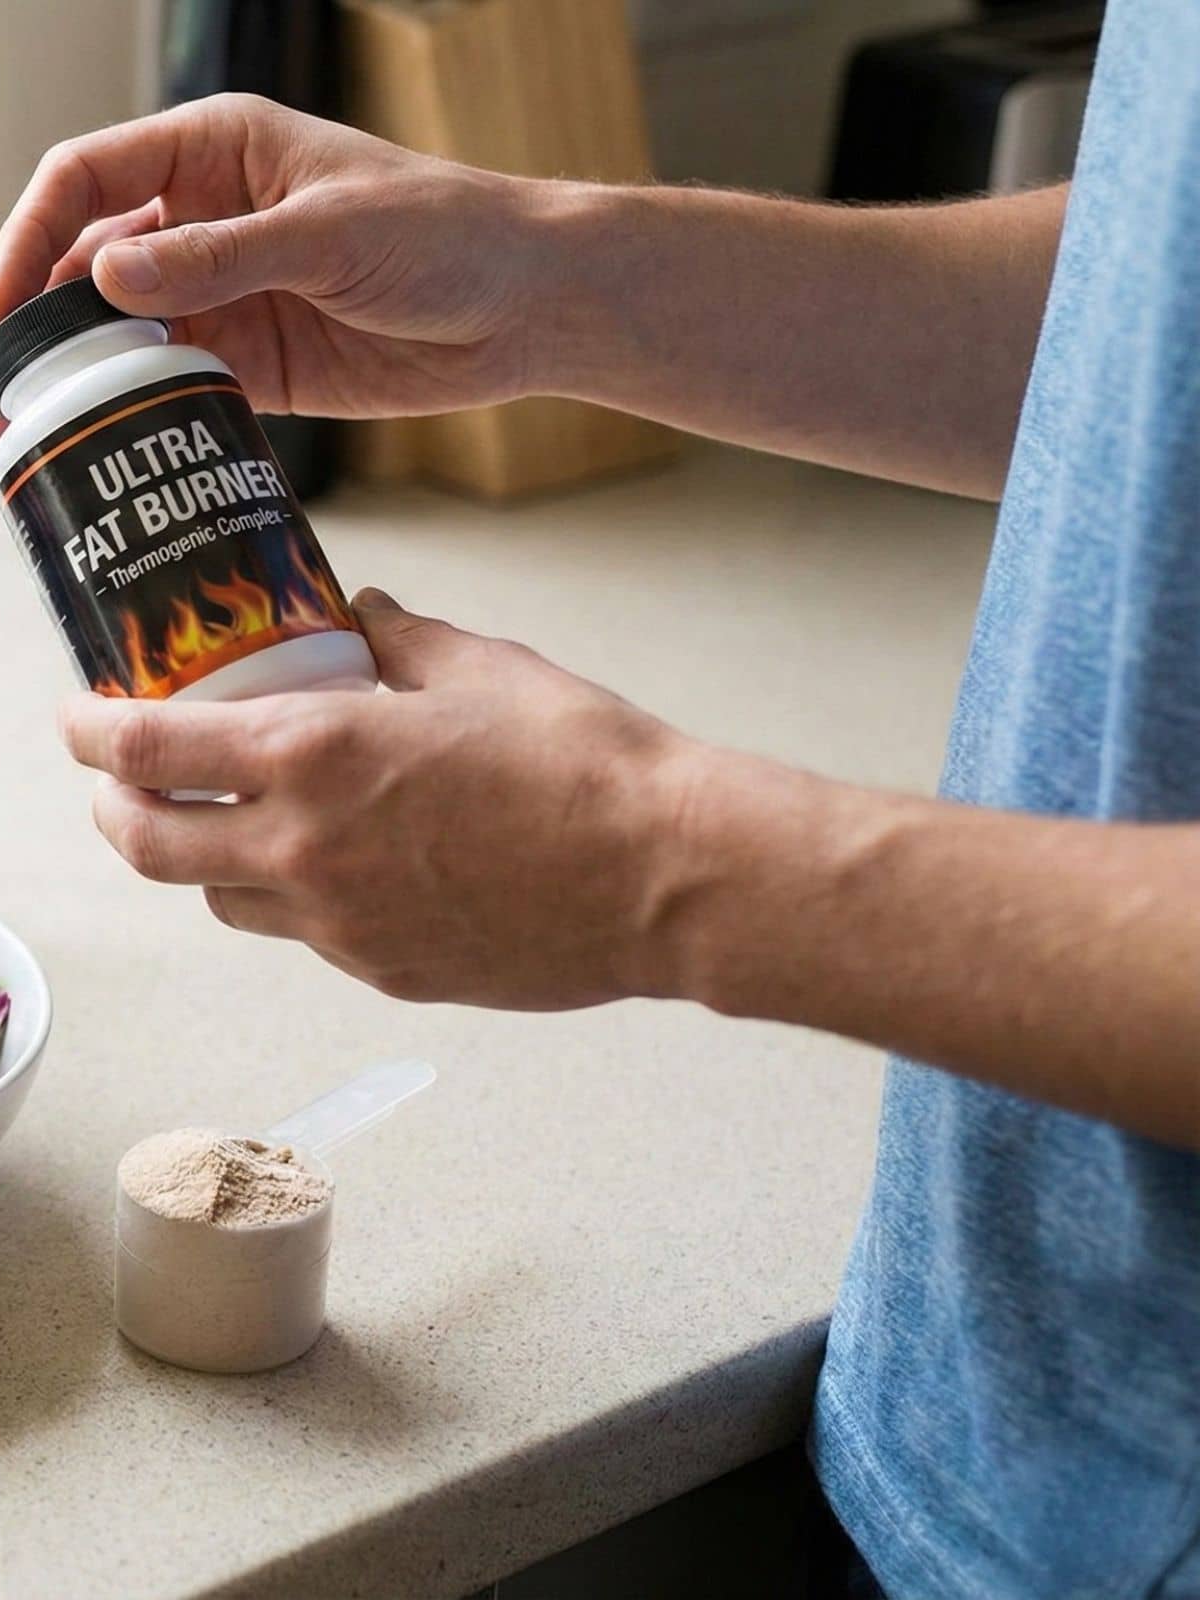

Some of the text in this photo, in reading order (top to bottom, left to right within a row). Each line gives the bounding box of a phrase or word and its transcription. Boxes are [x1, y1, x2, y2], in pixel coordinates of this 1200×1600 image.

[88, 419, 224, 501] ULTRA
[63, 459, 288, 584] FAT BURNER
[107, 507, 283, 590] Thermogenic Complex
